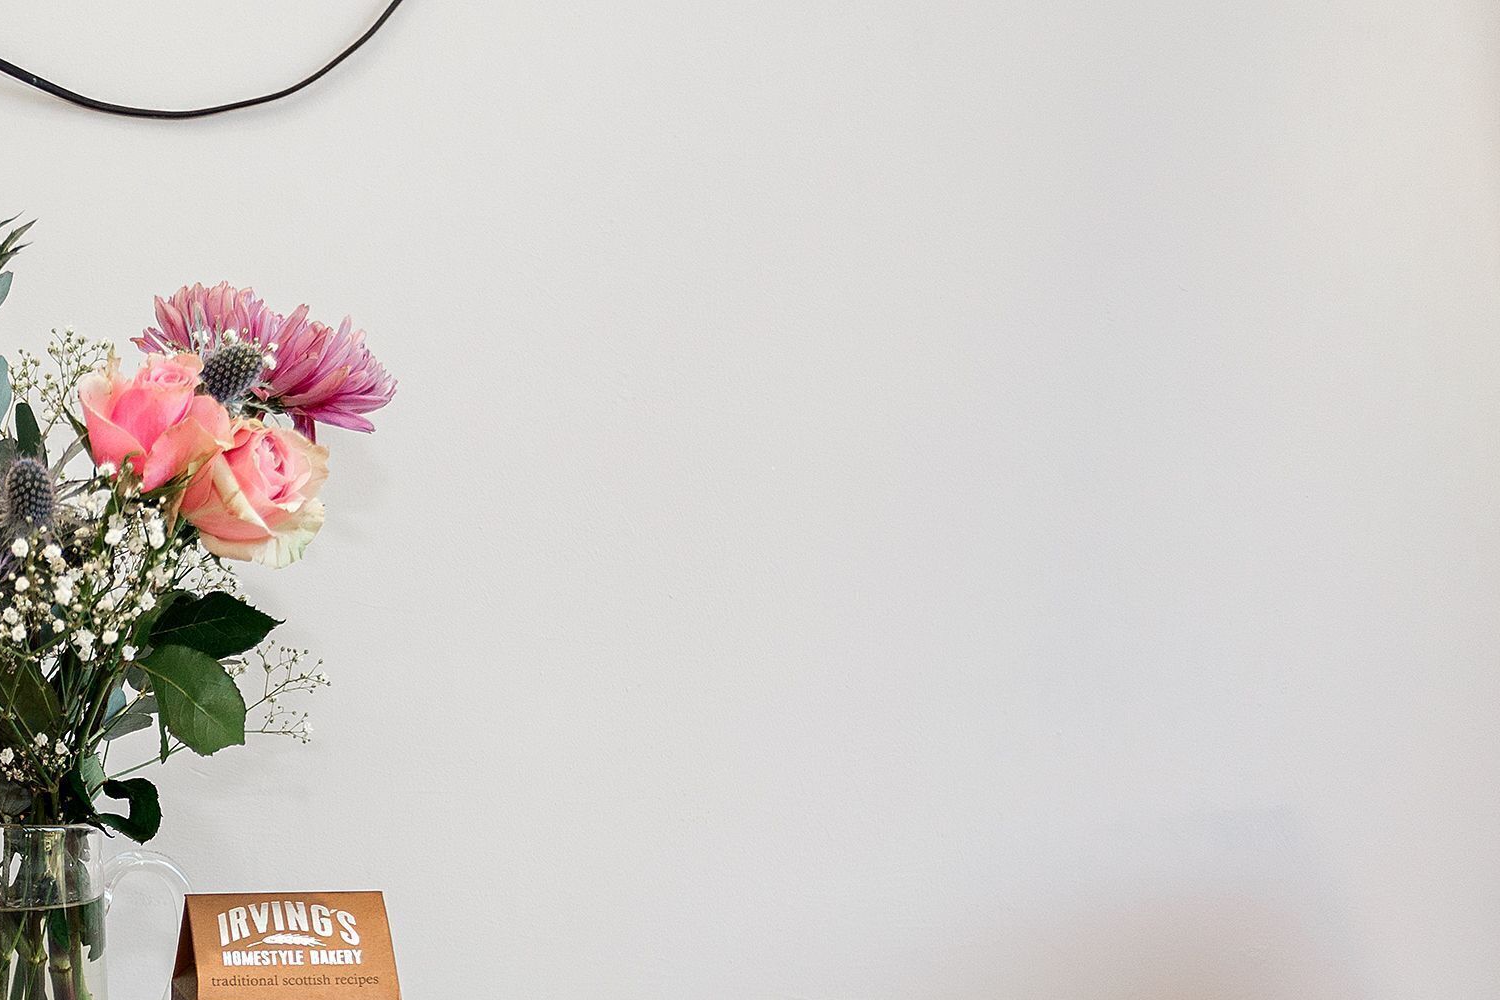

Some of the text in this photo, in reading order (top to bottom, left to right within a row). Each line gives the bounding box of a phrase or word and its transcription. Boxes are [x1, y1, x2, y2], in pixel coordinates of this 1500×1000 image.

[216, 900, 361, 948] IRVING'S
[222, 949, 363, 967] HOMESTYLE BAKERY
[210, 973, 380, 988] traditional scottish recipes
